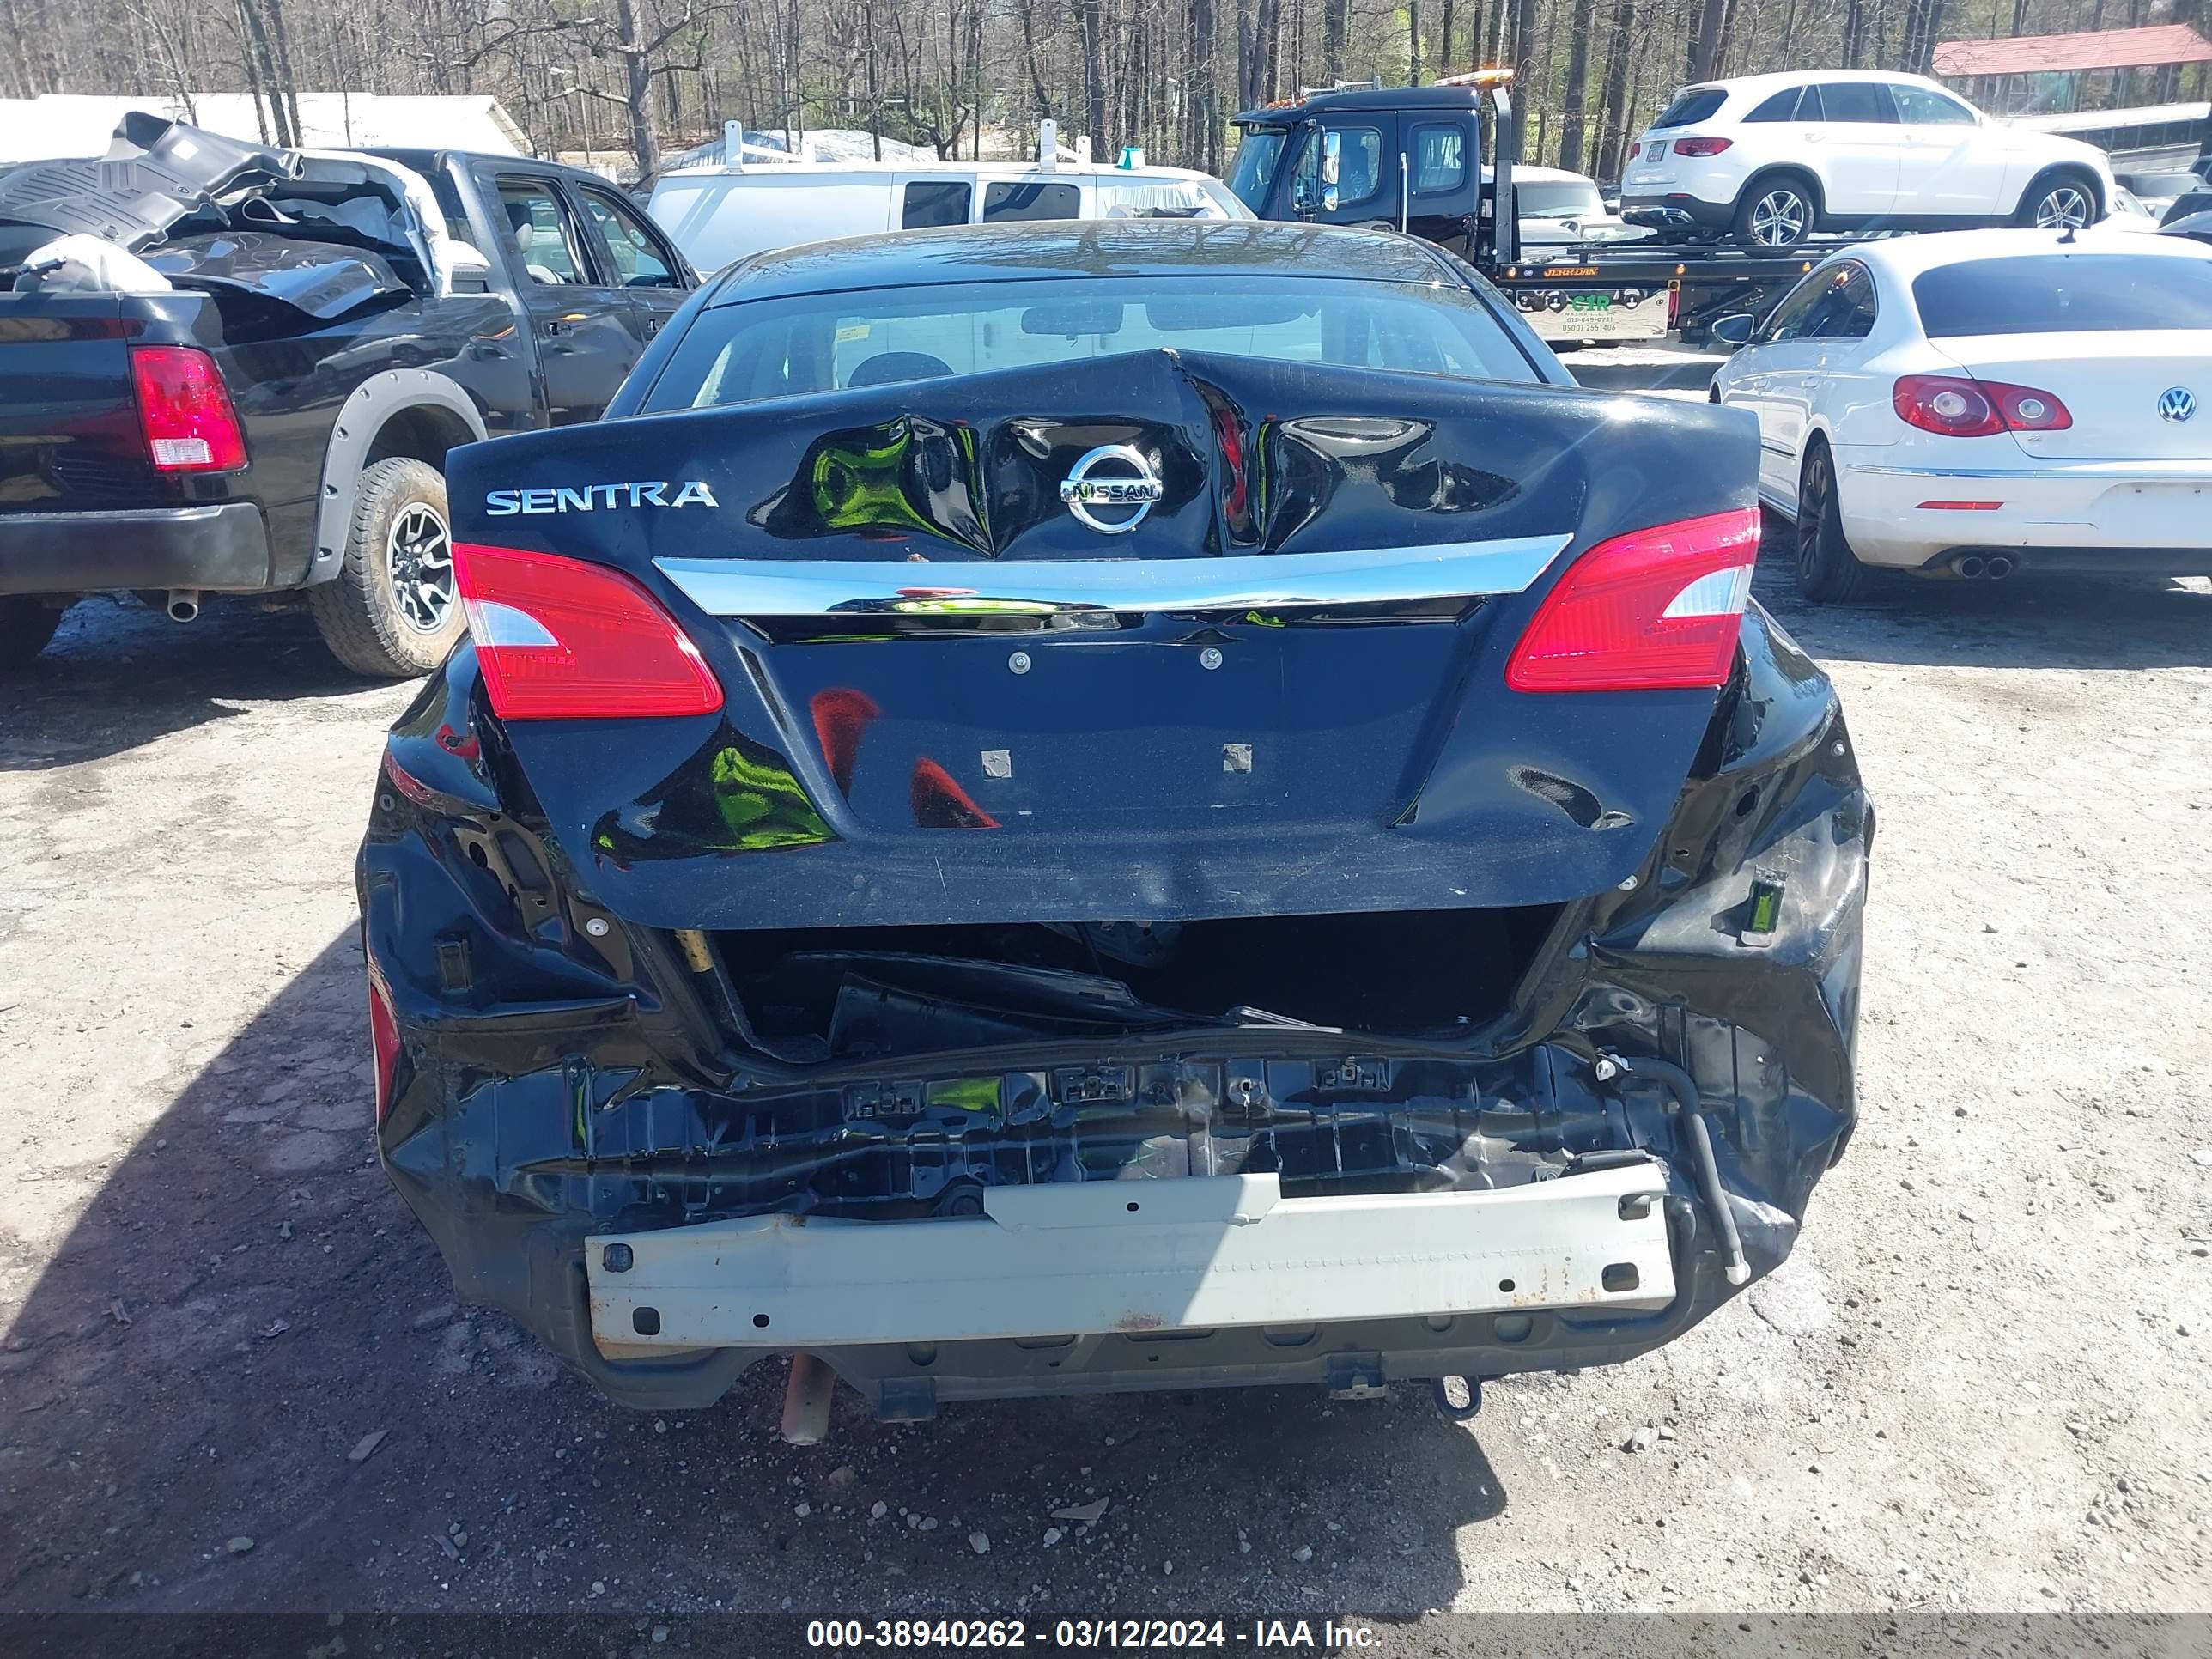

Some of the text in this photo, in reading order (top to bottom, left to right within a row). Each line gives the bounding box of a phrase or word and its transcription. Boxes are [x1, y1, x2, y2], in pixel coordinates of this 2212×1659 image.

[1563, 324, 1583, 332] USDOT
[2158, 386, 2197, 422] VW
[486, 481, 720, 515] SENTRA
[1073, 484, 1155, 499] NISSAN
